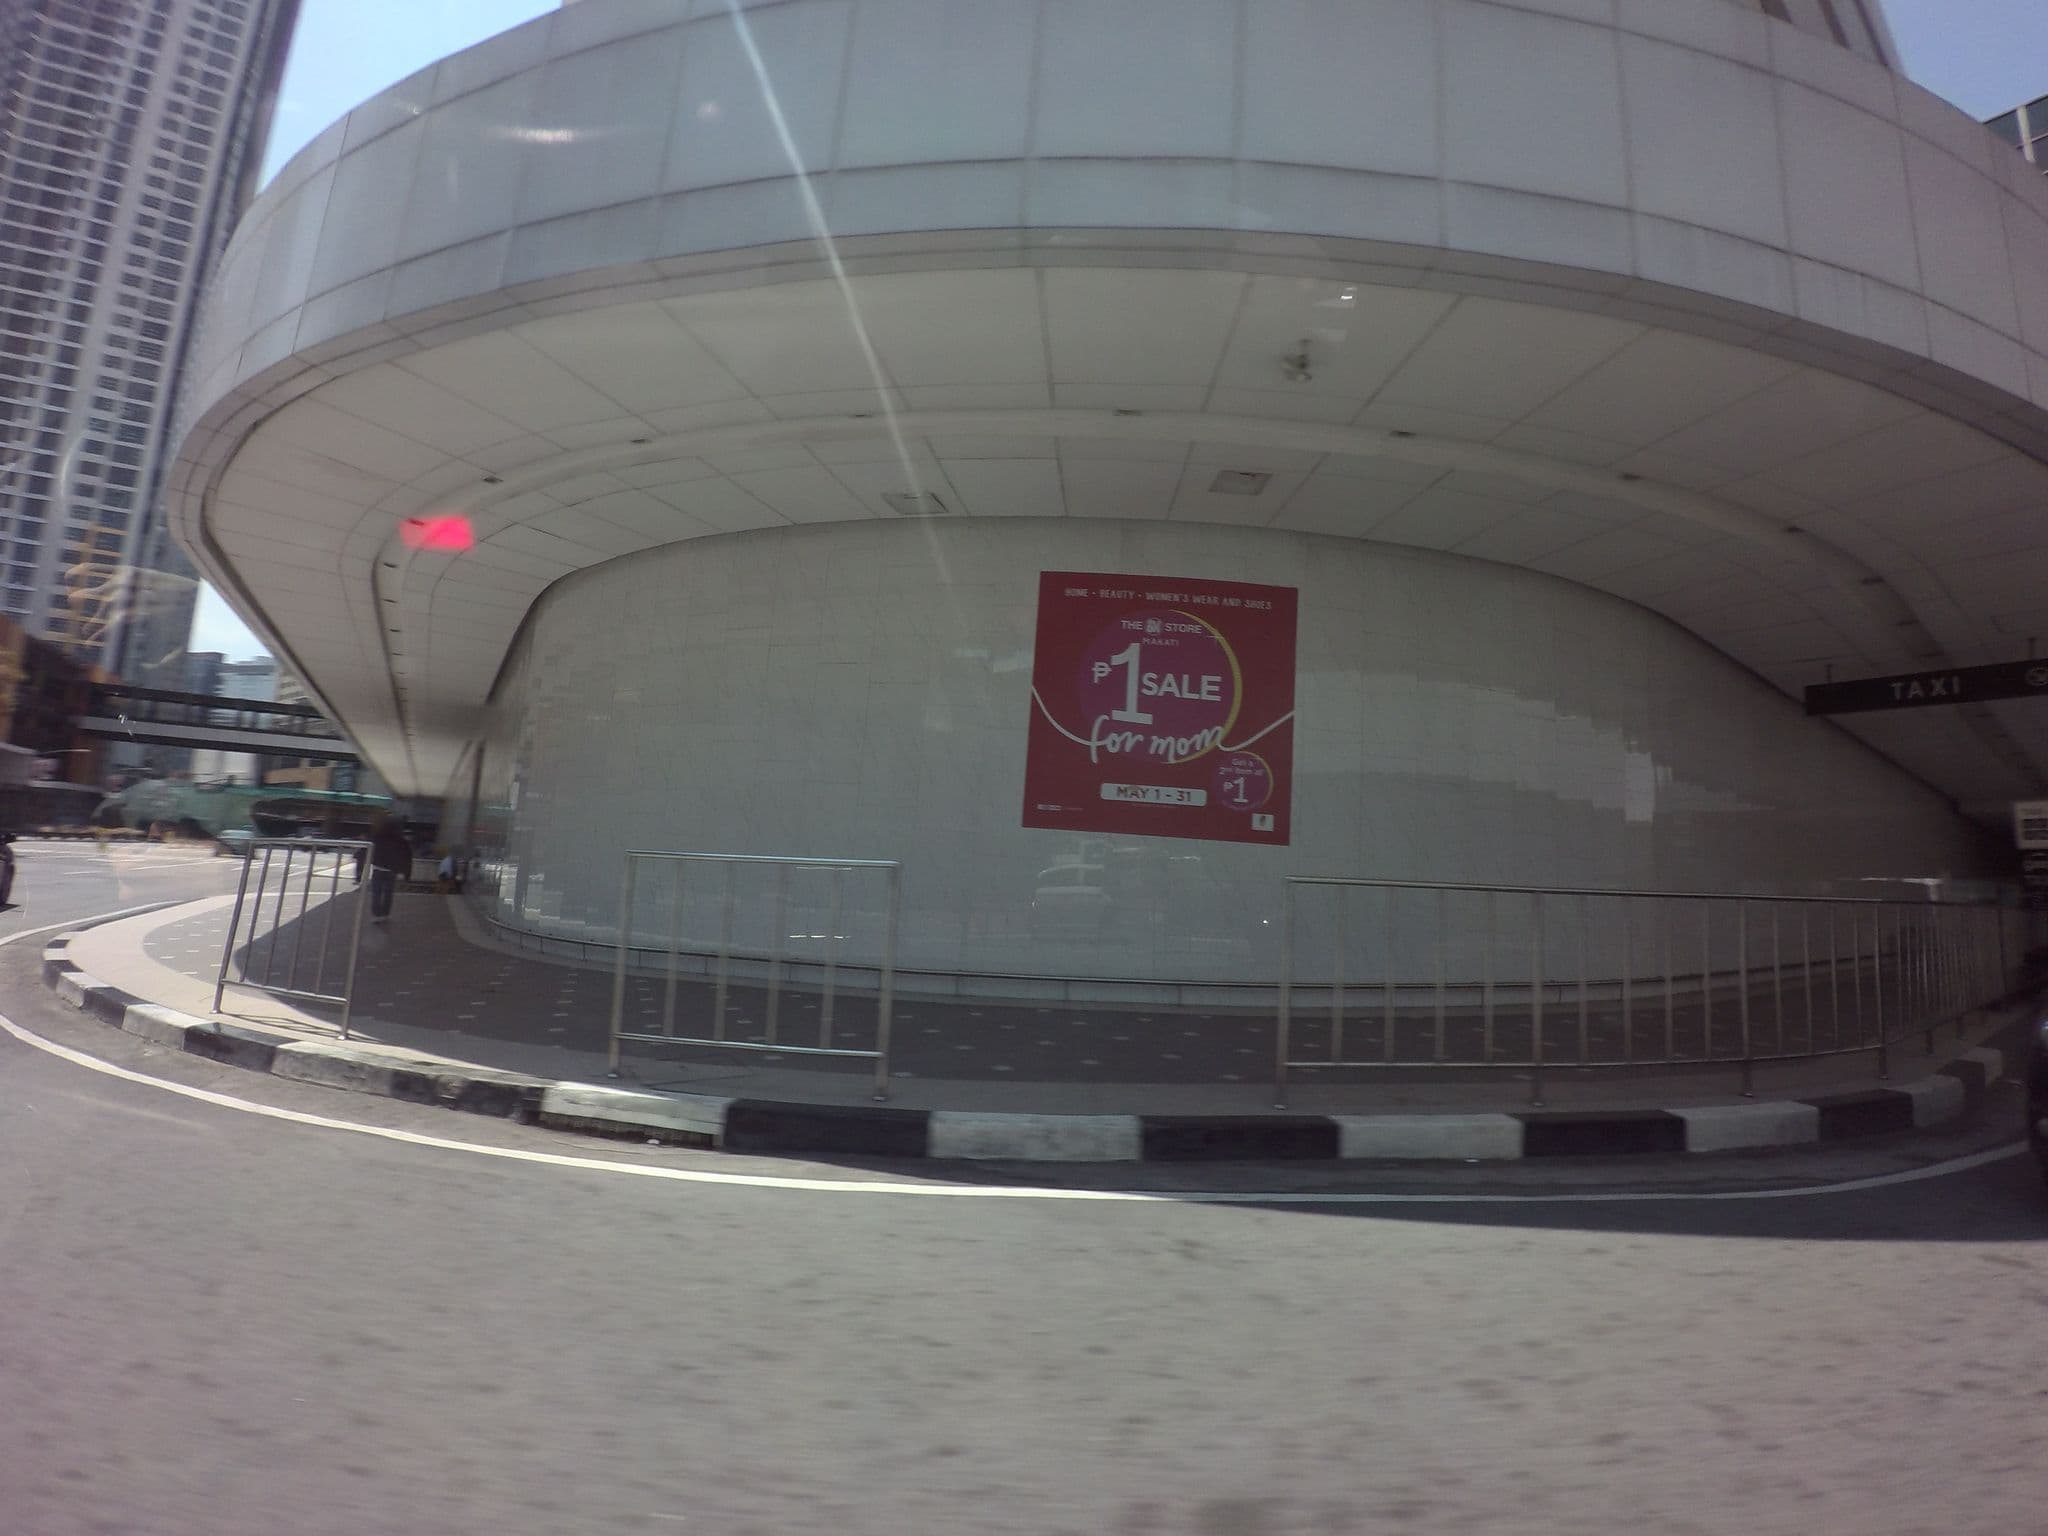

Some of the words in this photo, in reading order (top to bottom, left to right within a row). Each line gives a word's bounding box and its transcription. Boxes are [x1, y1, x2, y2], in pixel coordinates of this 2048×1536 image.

[1120, 619, 1143, 631] THE
[1164, 622, 1203, 635] STORE
[1142, 671, 1223, 702] SALE
[1890, 675, 1960, 700] TAXI
[1089, 714, 1144, 764] for
[1150, 725, 1224, 763] mom
[1116, 785, 1150, 799] MAY
[1176, 789, 1192, 802] 31
